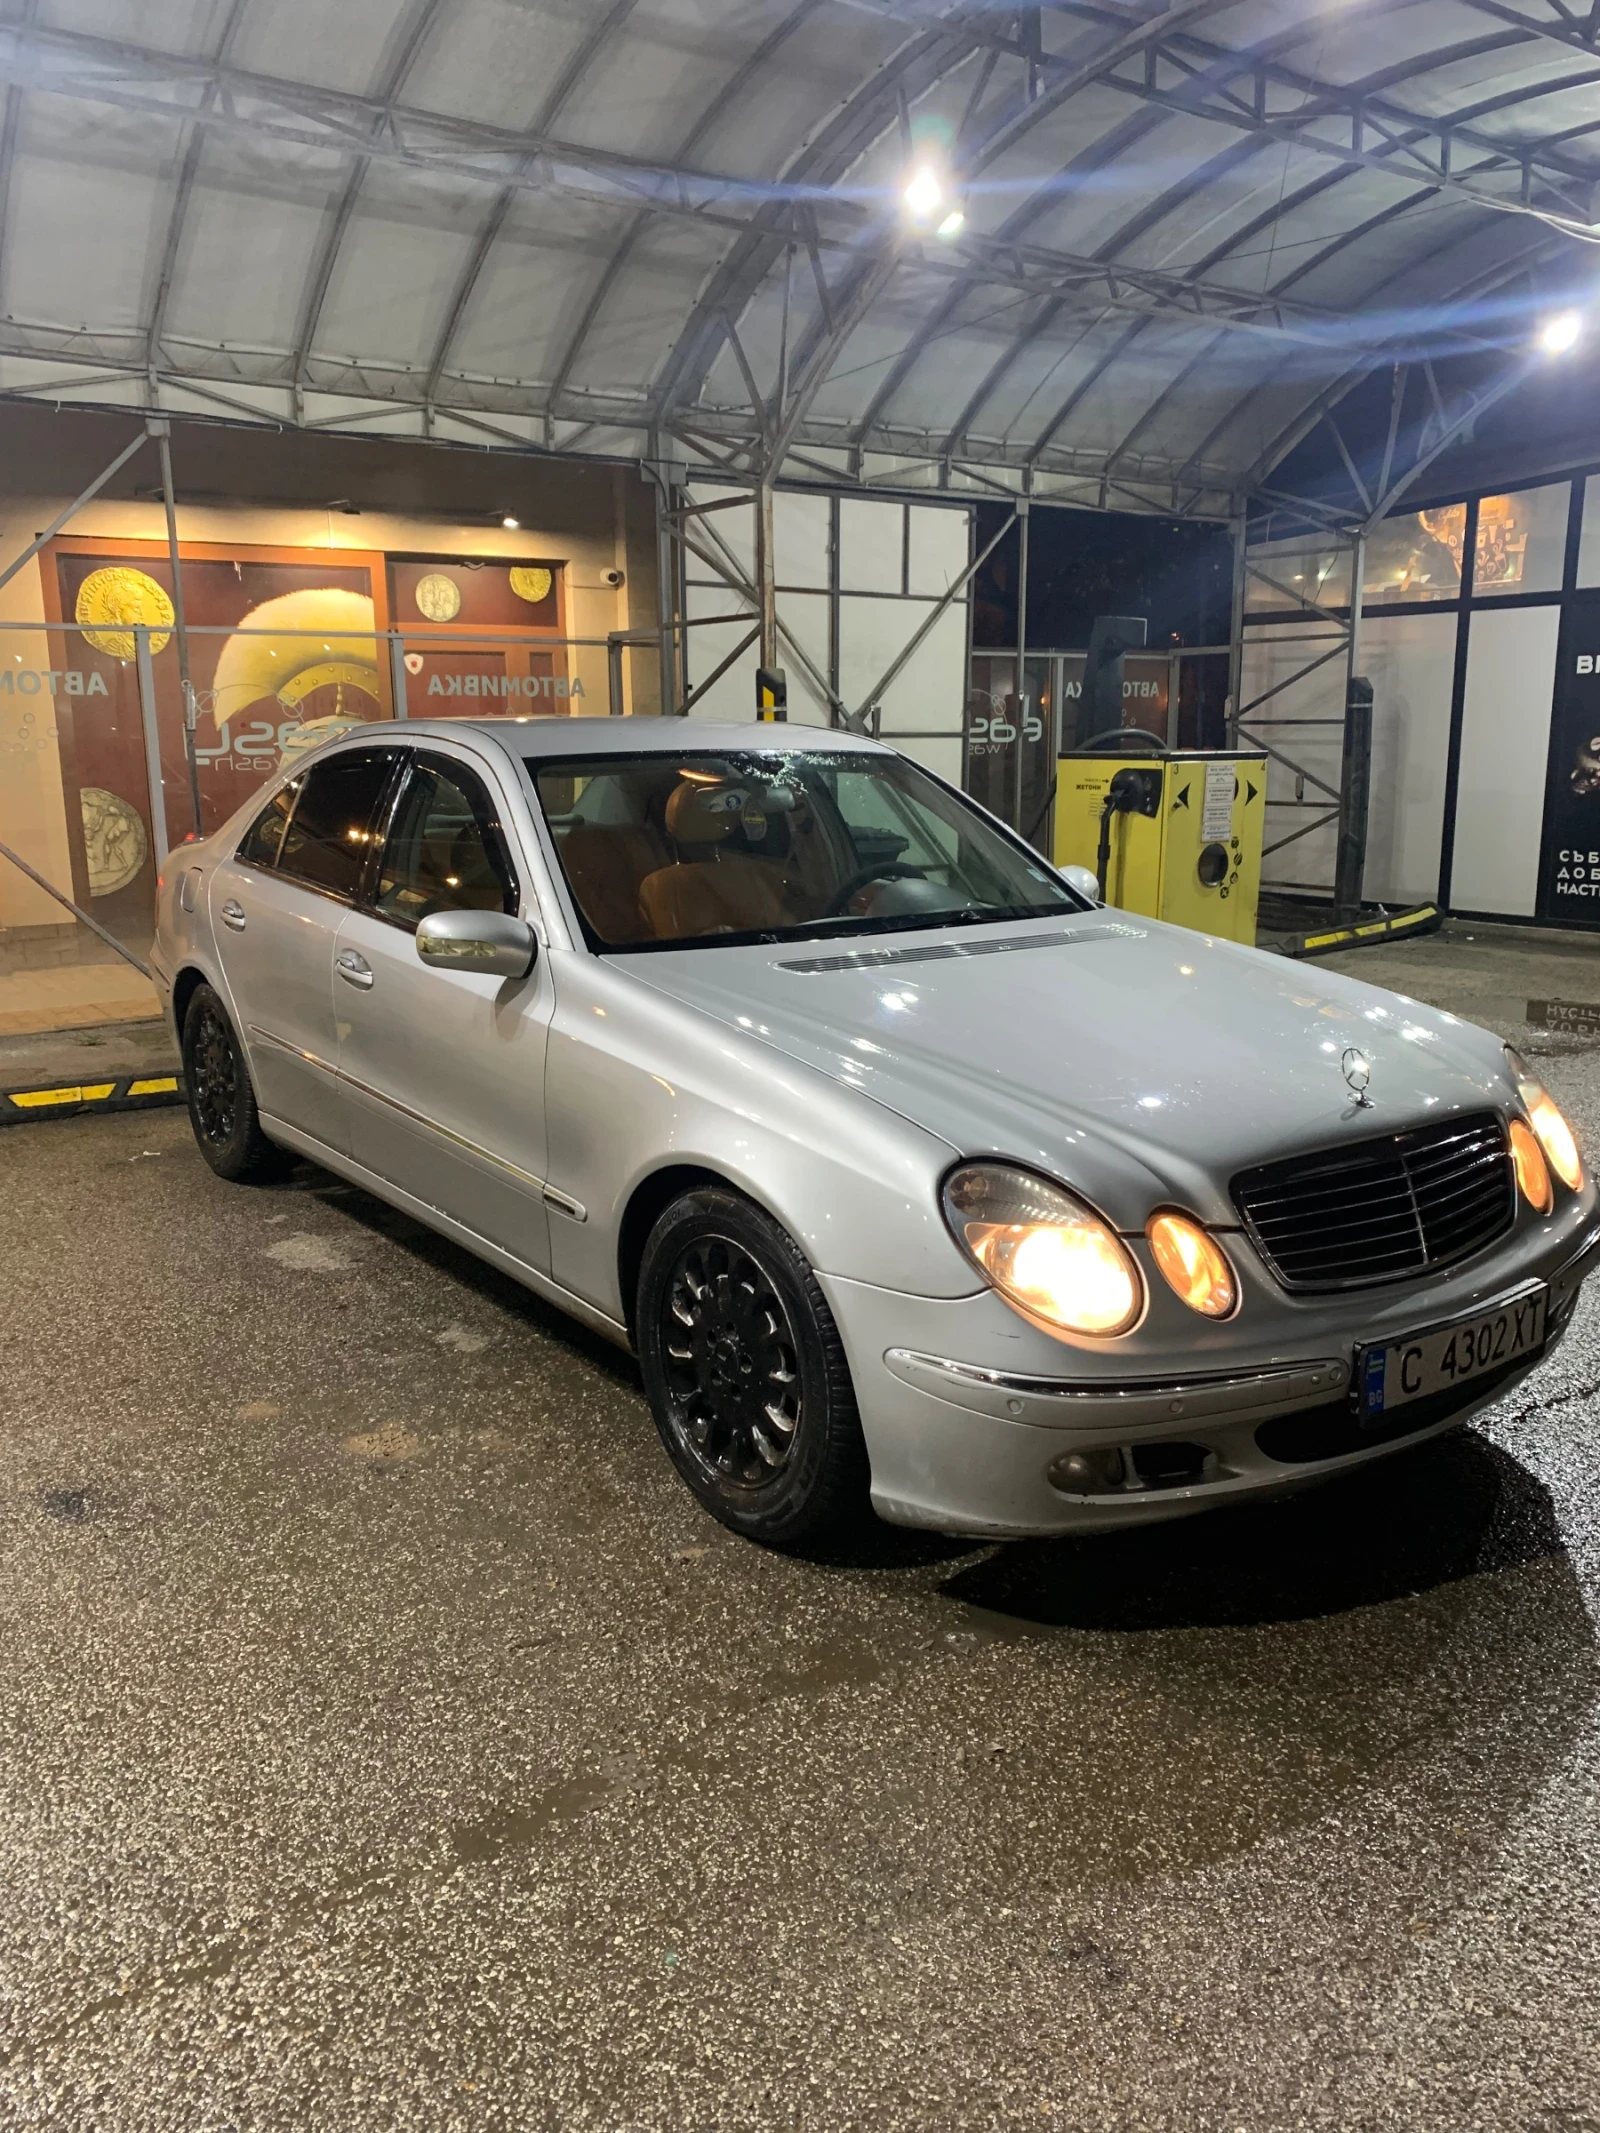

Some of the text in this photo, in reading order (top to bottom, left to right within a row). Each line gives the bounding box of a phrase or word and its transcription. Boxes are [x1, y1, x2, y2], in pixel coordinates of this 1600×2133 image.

[1173, 763, 1180, 775] 3
[1556, 881, 1600, 897] НАСТ
[1401, 1347, 1422, 1394] C
[1368, 1389, 1383, 1406] BG
